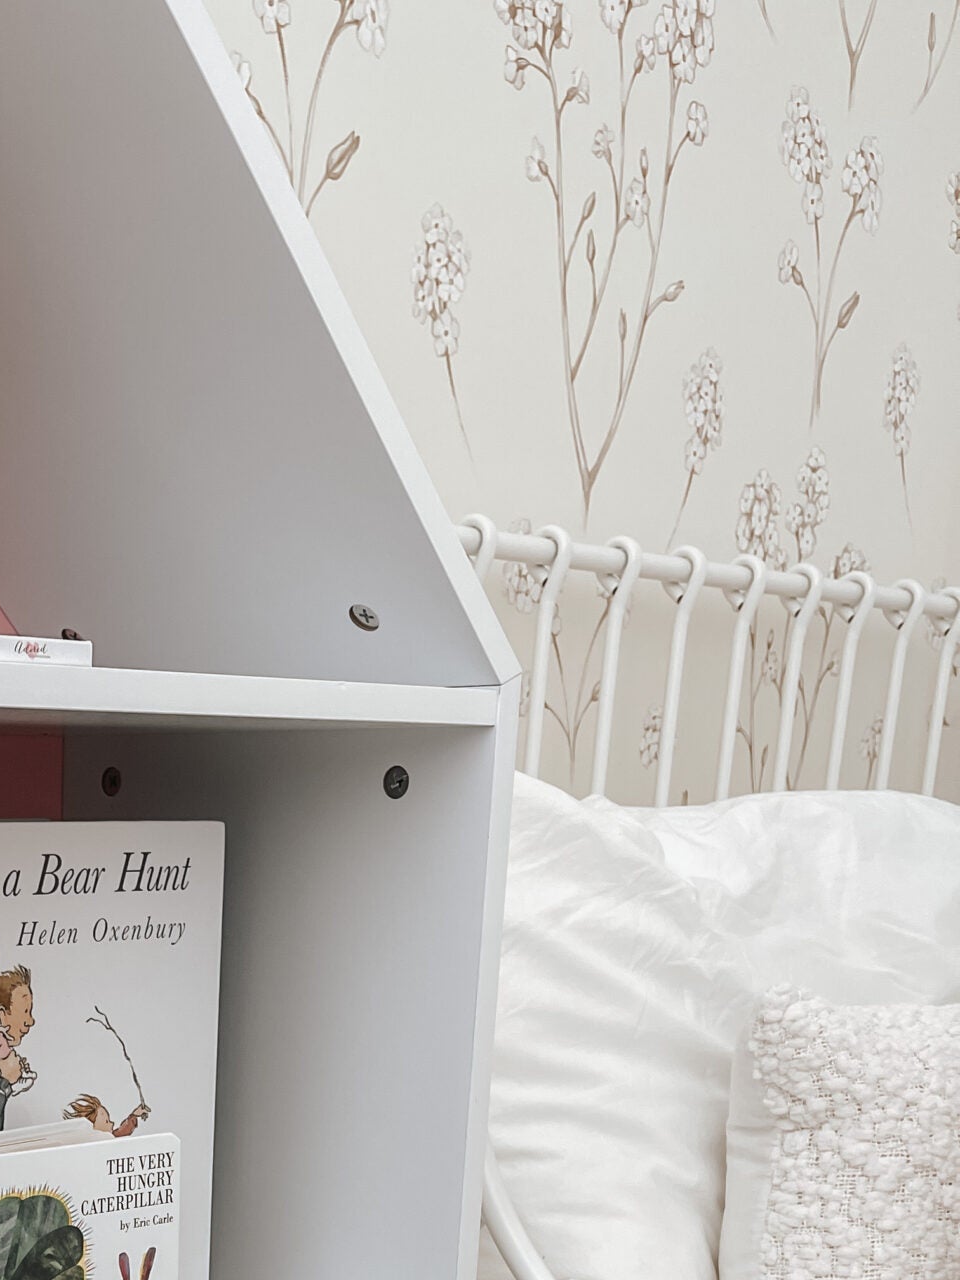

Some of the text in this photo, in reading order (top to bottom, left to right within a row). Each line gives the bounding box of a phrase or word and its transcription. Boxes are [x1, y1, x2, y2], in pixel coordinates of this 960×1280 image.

[3, 870, 21, 897] a
[33, 853, 105, 895] Bear
[115, 852, 191, 893] Hunt
[16, 917, 186, 947] Helen Oxenbury
[106, 1152, 174, 1175] THE VERY
[117, 1170, 174, 1192] HUNGRY
[81, 1188, 174, 1216] CATERPILLAR
[120, 1213, 174, 1233] by Eric Carle
